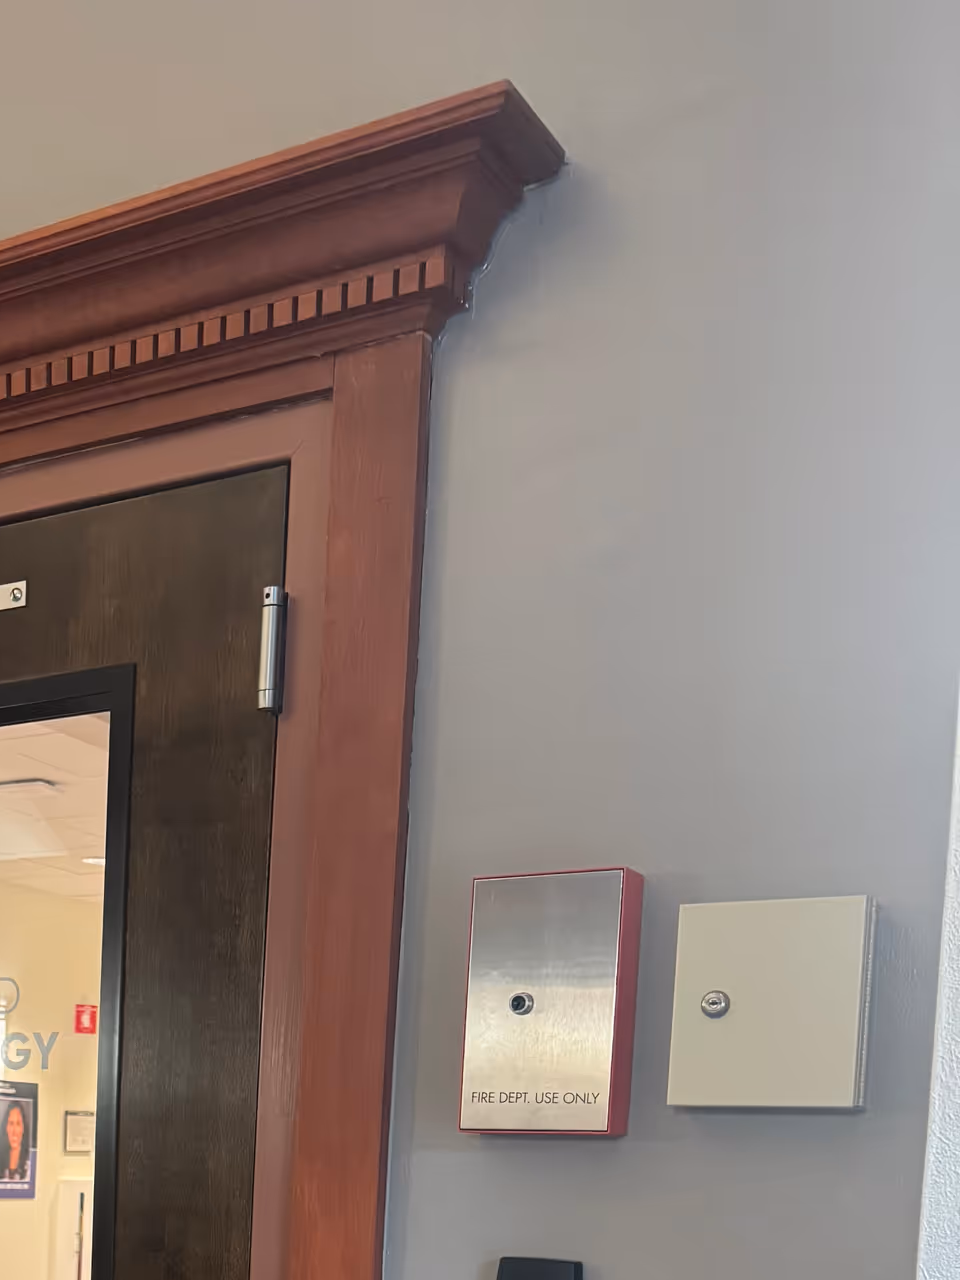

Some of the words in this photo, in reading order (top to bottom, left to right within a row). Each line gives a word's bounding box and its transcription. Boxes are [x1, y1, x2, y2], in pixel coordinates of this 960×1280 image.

[471, 1091, 495, 1104] FIRE
[499, 1091, 530, 1104] DEPT.
[535, 1092, 559, 1105] USE
[563, 1092, 600, 1105] ONLY
